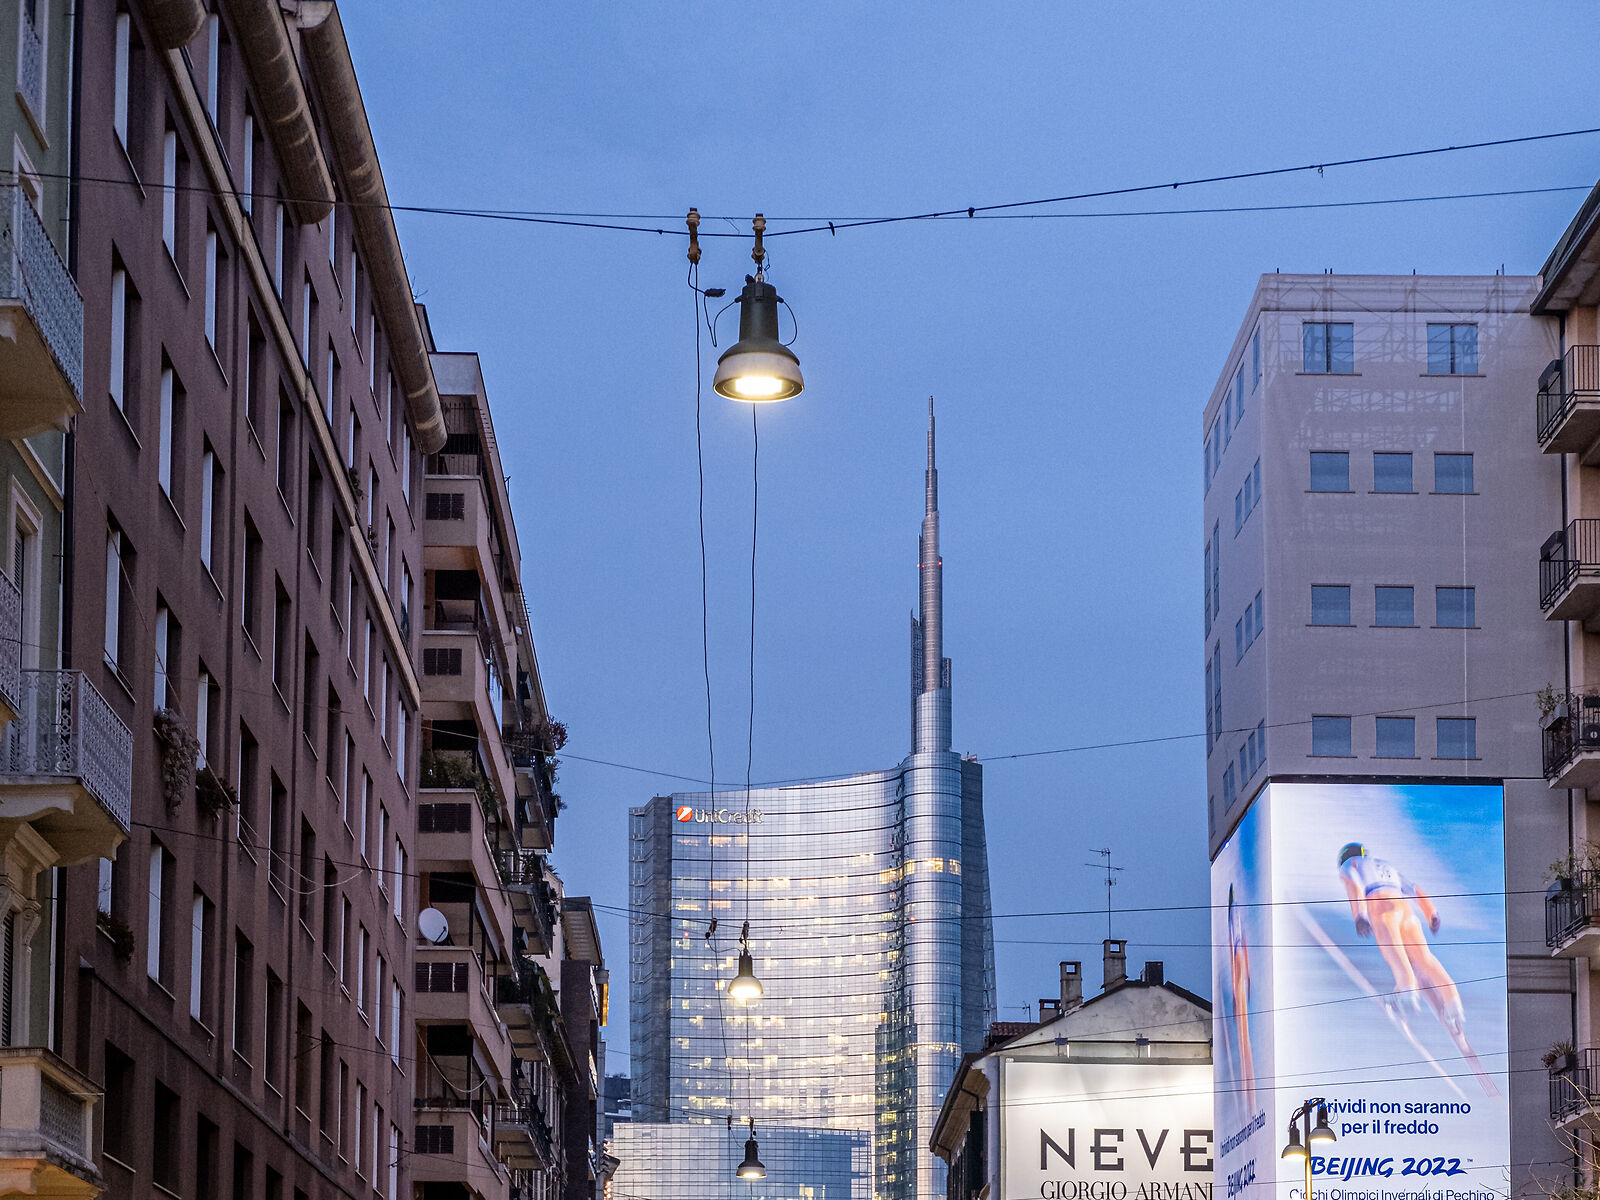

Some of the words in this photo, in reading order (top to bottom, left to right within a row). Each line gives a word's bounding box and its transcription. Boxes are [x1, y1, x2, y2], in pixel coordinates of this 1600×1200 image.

[695, 808, 763, 824] UniCredit
[1370, 1101, 1401, 1114] non
[1404, 1101, 1471, 1114] saranno
[1341, 1121, 1369, 1136] per
[1373, 1119, 1381, 1134] il
[1384, 1119, 1439, 1135] freddo
[1040, 1127, 1214, 1172] NEVE
[1311, 1156, 1394, 1181] BEIJING
[1401, 1157, 1468, 1177] 2022
[1040, 1180, 1127, 1200] GIORGIO
[1381, 1189, 1431, 1200] Invernali
[1432, 1189, 1444, 1200] di
[1446, 1189, 1495, 1200] Pechino
